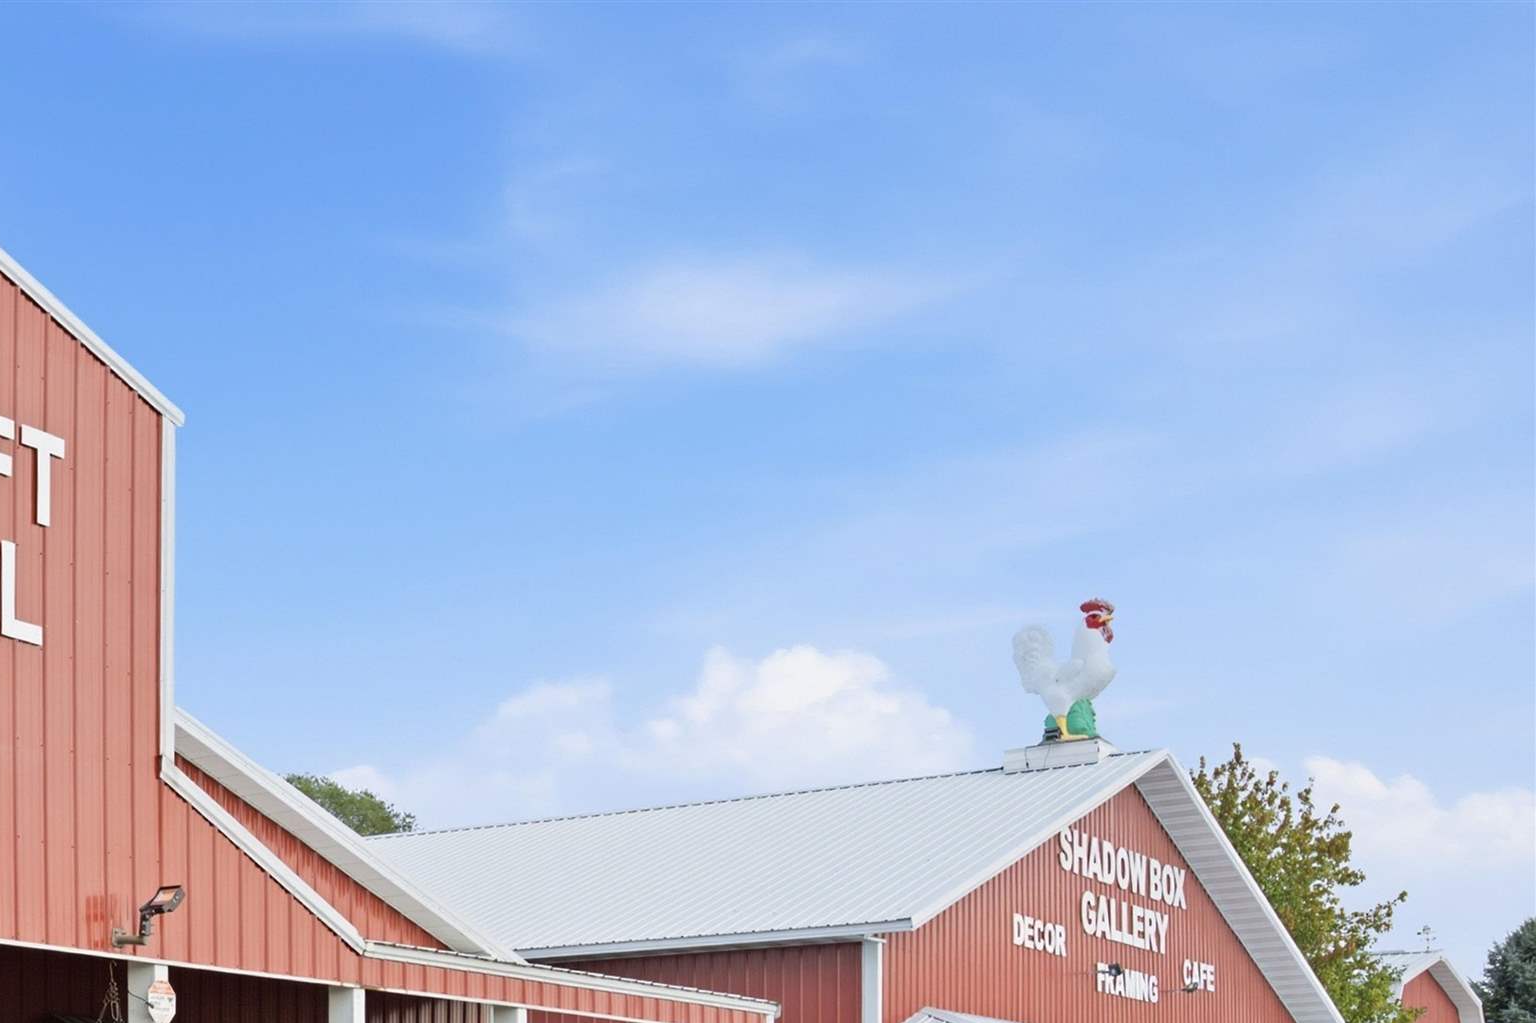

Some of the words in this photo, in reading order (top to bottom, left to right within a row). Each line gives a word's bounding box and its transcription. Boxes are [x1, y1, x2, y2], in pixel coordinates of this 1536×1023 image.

[1013, 912, 1067, 957] DECOR
[1081, 890, 1169, 954] GALLERY
[1096, 962, 1159, 1004] FRAMING
[1183, 959, 1215, 992] CAFE
